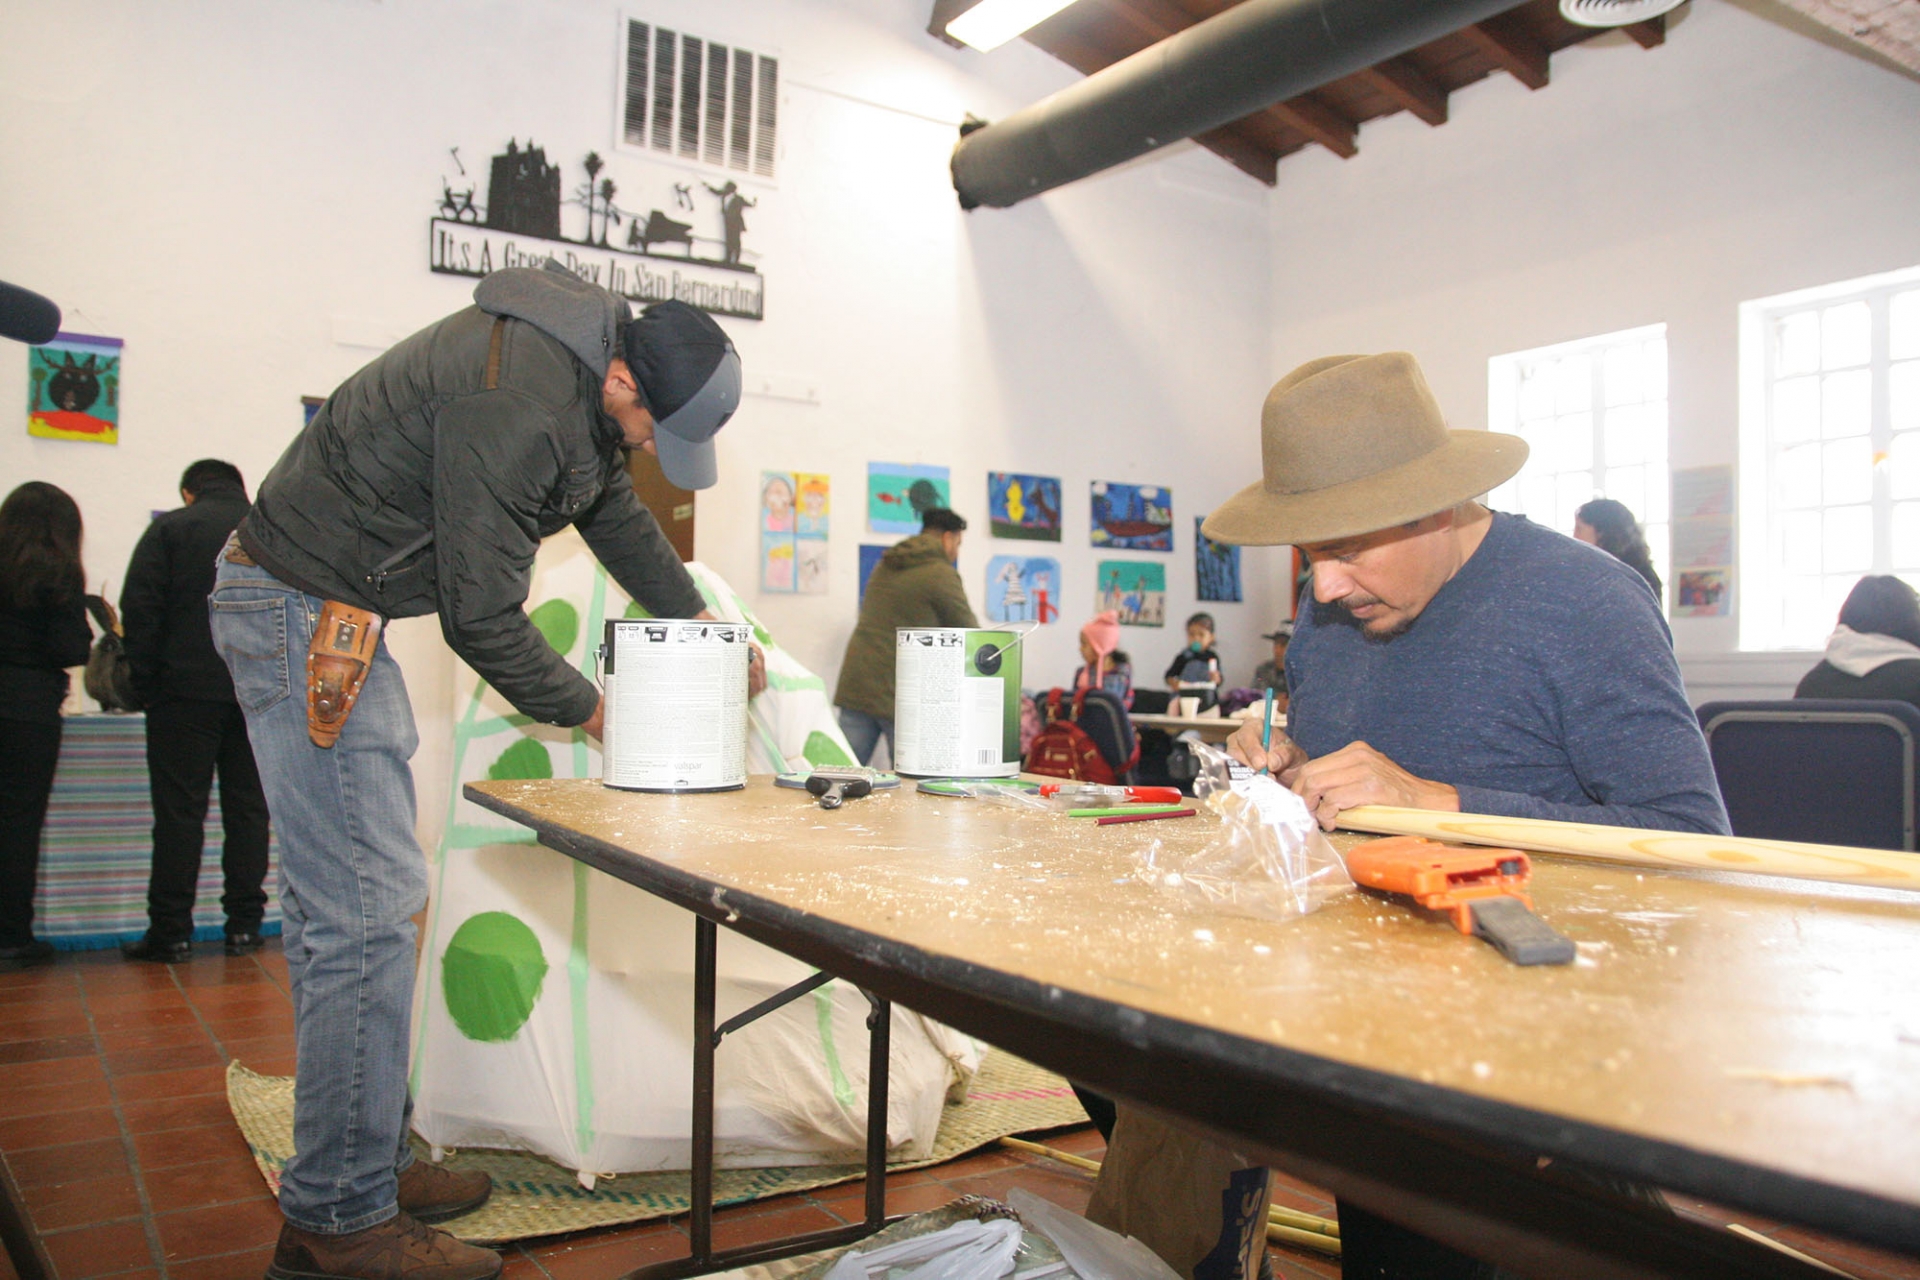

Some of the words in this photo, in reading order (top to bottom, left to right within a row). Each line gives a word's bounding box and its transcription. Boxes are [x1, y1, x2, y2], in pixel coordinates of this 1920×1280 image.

[481, 238, 493, 273] A
[610, 258, 626, 295] In
[633, 262, 667, 299] San
[672, 270, 762, 314] Bernardino
[674, 760, 703, 772] valspar
